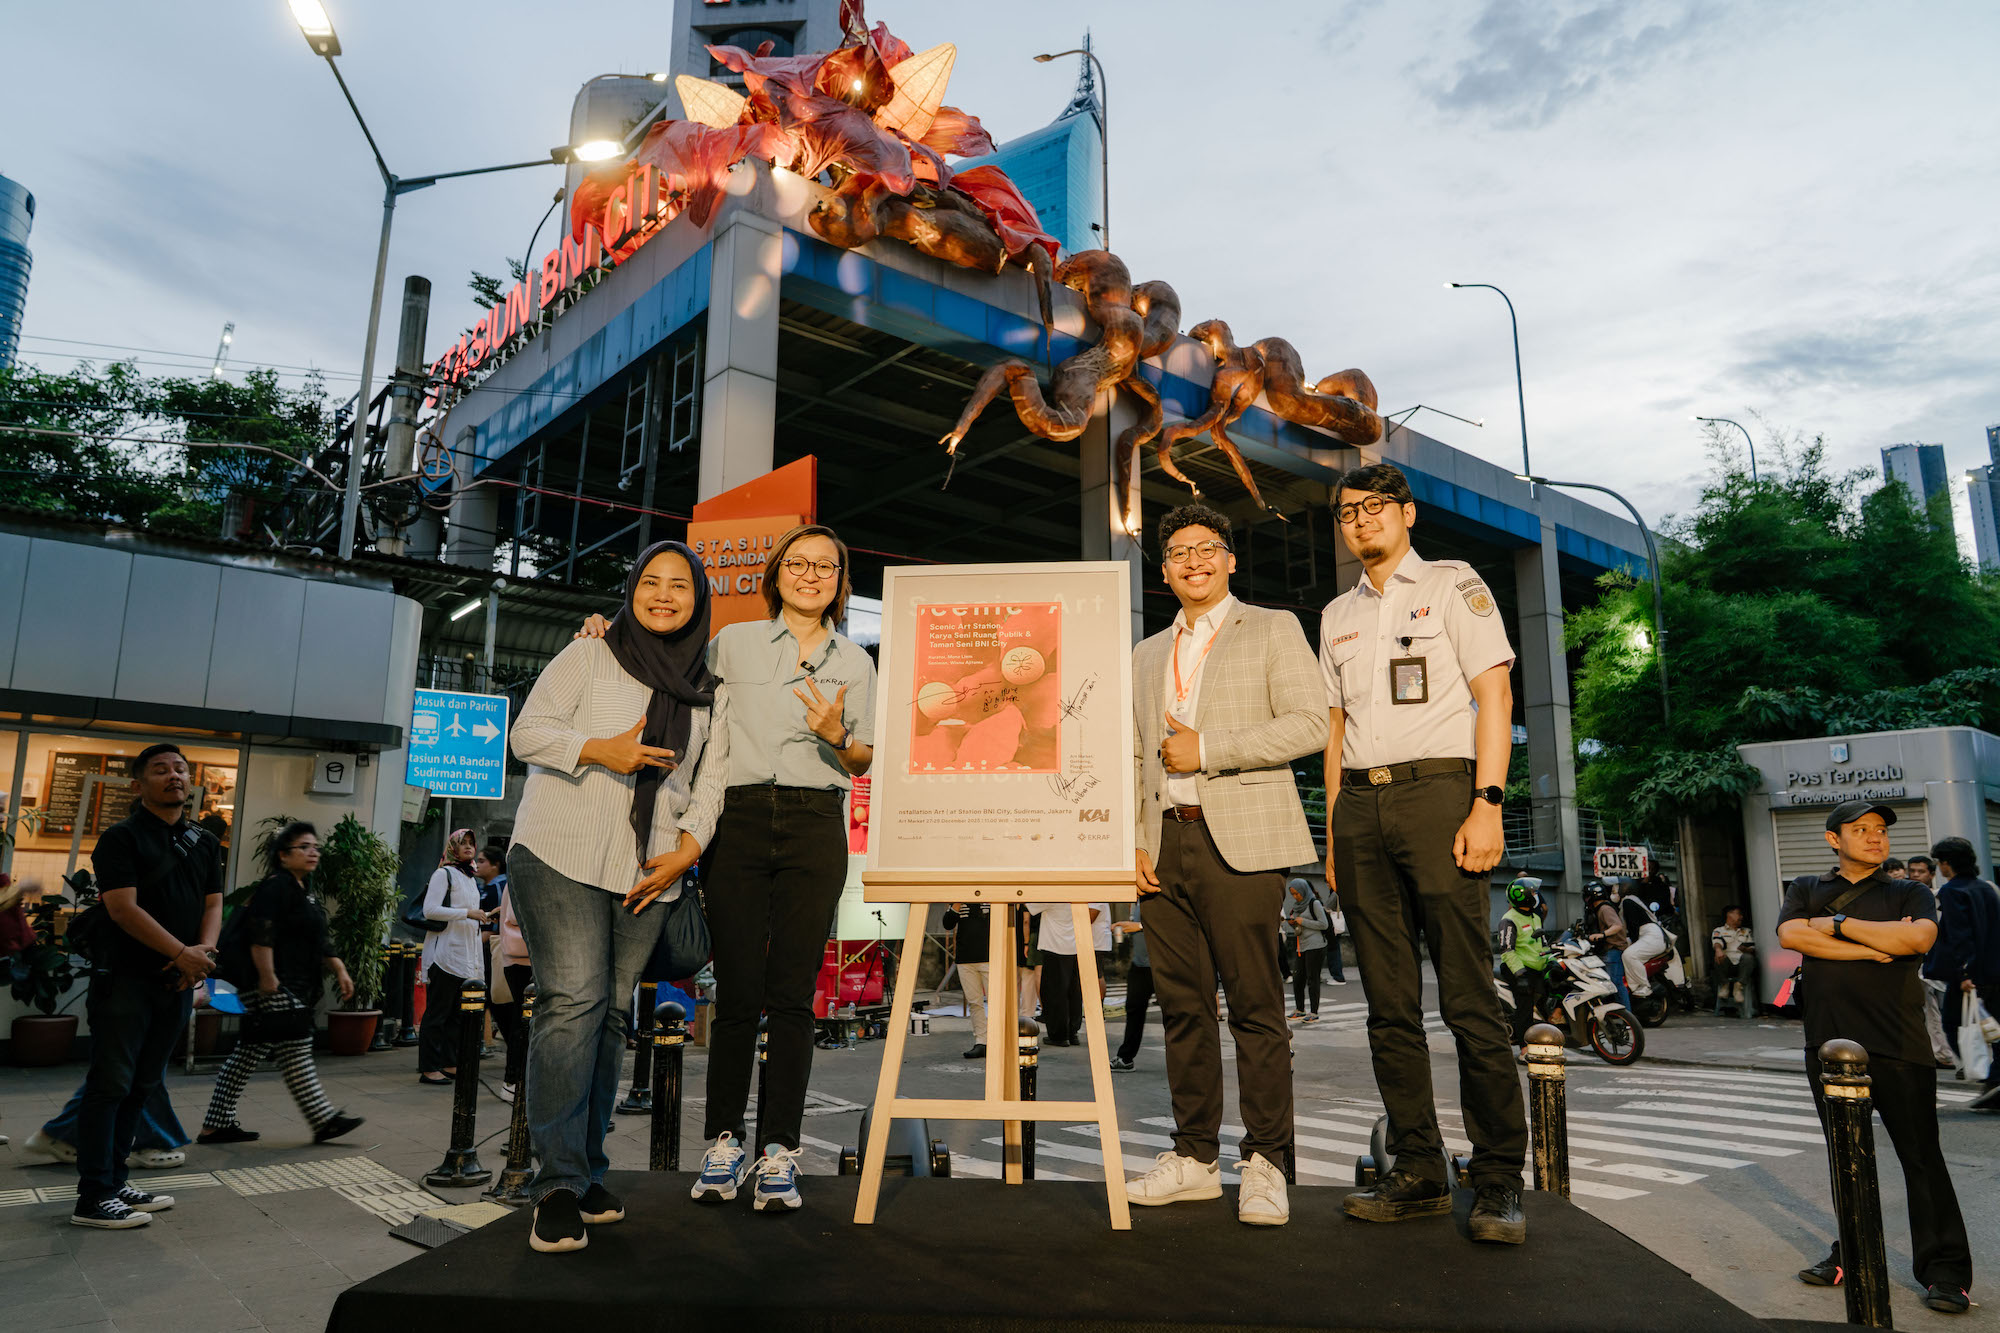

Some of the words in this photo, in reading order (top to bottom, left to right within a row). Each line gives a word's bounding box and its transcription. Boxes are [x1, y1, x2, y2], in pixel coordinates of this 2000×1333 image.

[426, 270, 533, 408] STASIUN
[540, 222, 593, 310] BNI
[603, 162, 676, 248] CIT
[695, 535, 774, 554] STASIU
[718, 551, 771, 567] BANDA
[709, 575, 730, 596] NI
[929, 623, 955, 631] Scenic
[972, 622, 1004, 630] Station,
[929, 632, 952, 640] Karya
[972, 631, 997, 639] Ruang
[1025, 630, 1031, 638] &
[991, 640, 1008, 648] City
[414, 696, 446, 708] Masuk
[448, 698, 467, 710] dan
[470, 700, 498, 712] Parkir
[409, 753, 440, 763] tasiun
[443, 755, 457, 765] KA
[460, 756, 500, 767] Bandara
[414, 767, 462, 779] Sudirman
[465, 769, 488, 780] Baru
[1787, 771, 1821, 787] Pos
[1824, 764, 1903, 785] Terpadu
[1787, 790, 1860, 805] Terowongan
[1863, 786, 1905, 800] Kendal
[1079, 809, 1110, 822] KAI
[1600, 853, 1639, 869] OJEK
